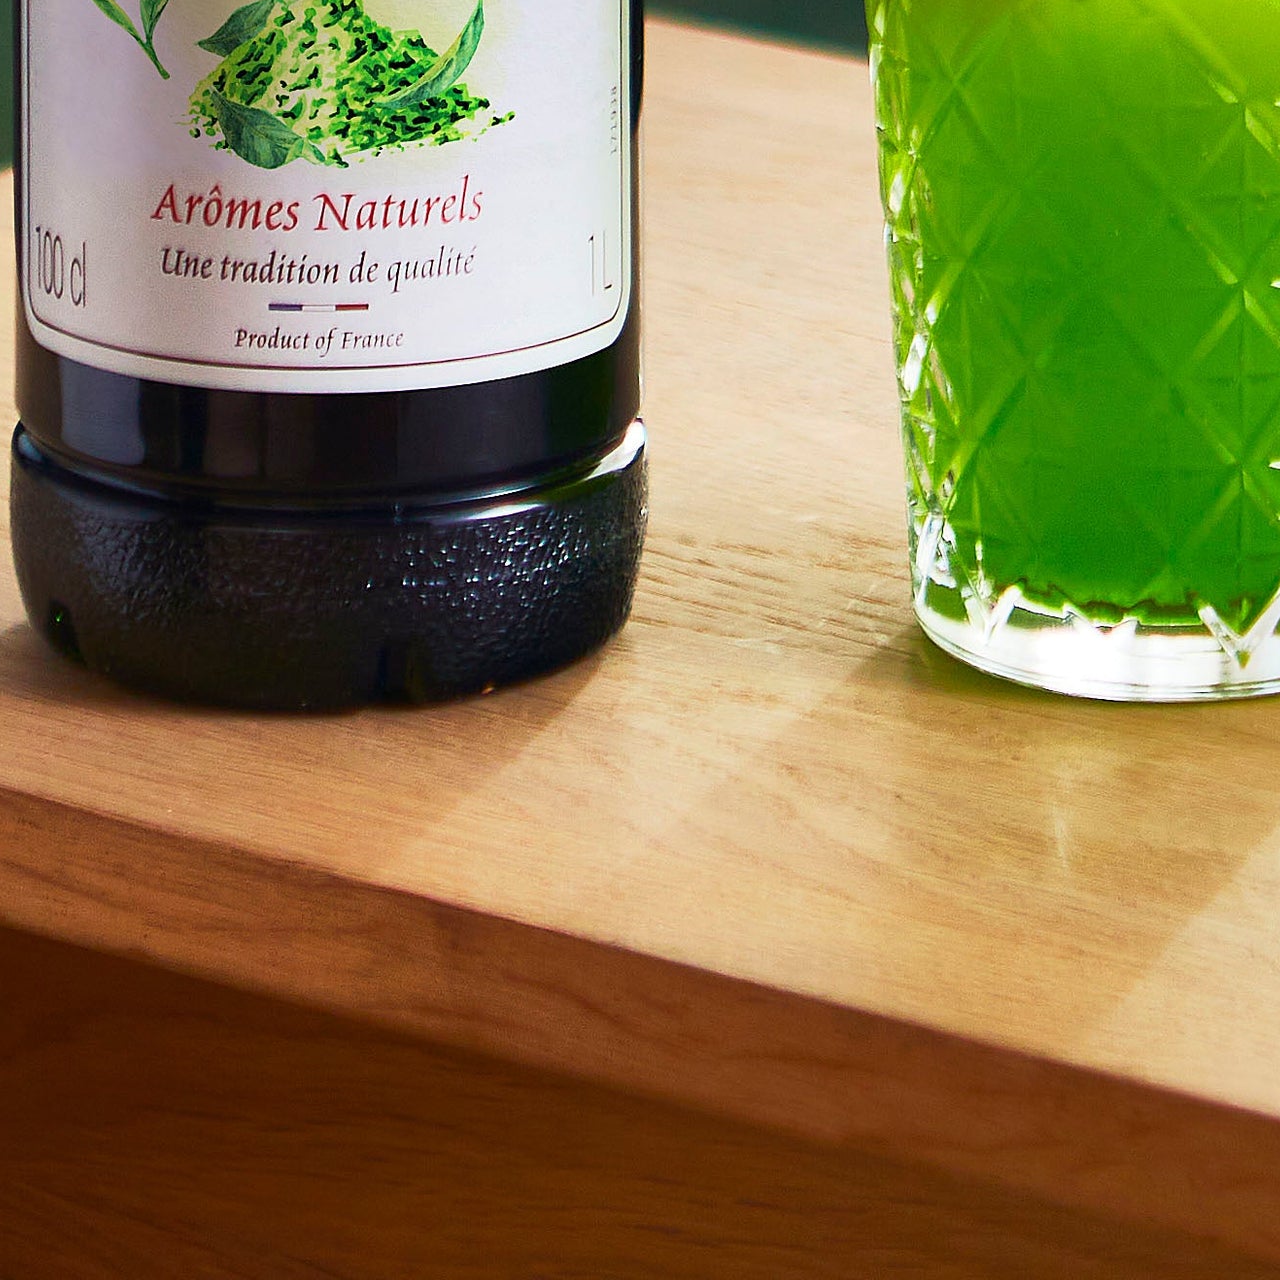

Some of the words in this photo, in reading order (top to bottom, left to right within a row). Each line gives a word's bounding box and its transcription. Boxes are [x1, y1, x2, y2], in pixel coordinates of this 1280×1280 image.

[149, 183, 301, 232] Arômes
[312, 173, 484, 231] Naturels
[35, 224, 65, 300] 100
[70, 241, 87, 309] cl
[160, 246, 214, 280] Une
[220, 249, 340, 286] tradition
[348, 250, 380, 284] de
[386, 244, 477, 295] qualité
[234, 325, 311, 350] Product
[314, 326, 339, 359] of
[341, 329, 405, 350] France
